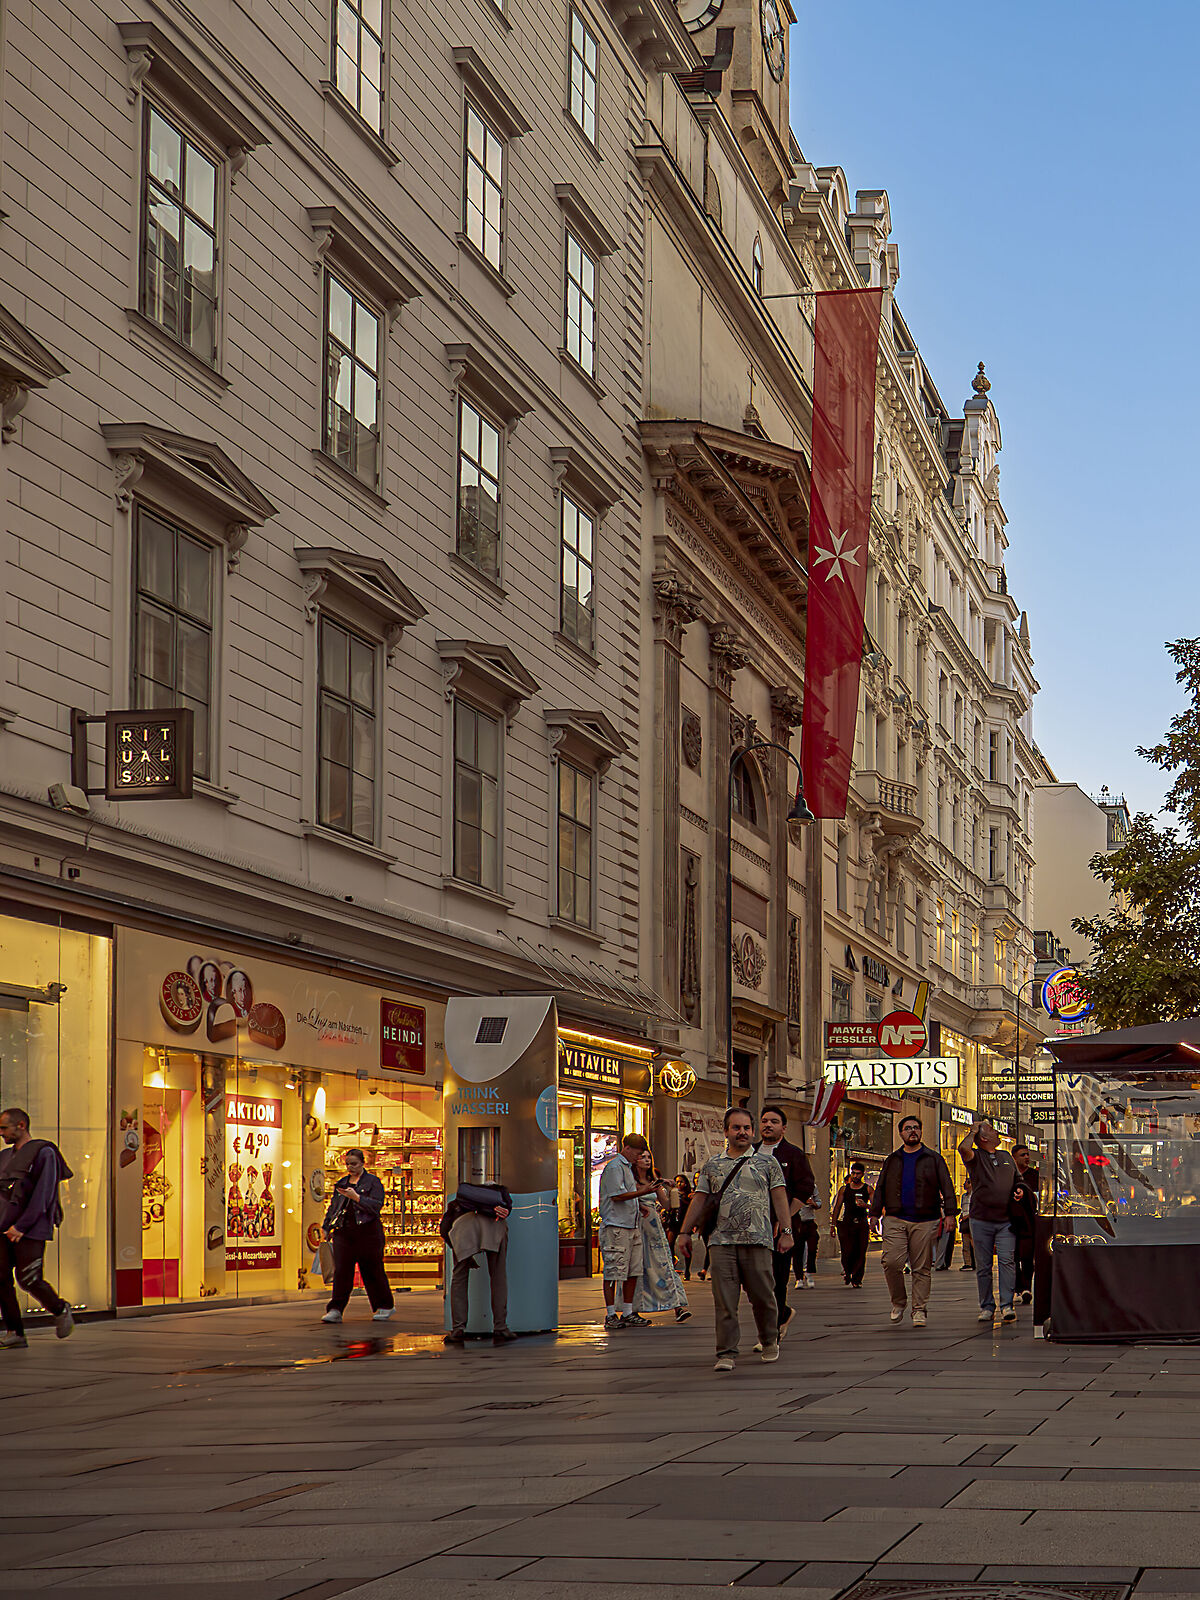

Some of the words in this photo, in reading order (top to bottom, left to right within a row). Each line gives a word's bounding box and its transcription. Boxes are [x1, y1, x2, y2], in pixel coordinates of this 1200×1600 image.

[296, 1013, 307, 1024] Die
[328, 1021, 338, 1029] am
[338, 1021, 363, 1035] Naschen
[832, 1026, 863, 1034] MAYR
[383, 1025, 423, 1046] HEINDL
[829, 1036, 876, 1044] FESSLER
[880, 1025, 926, 1046] MF
[565, 1050, 619, 1076] VITAVIEN
[825, 1061, 948, 1087] TARDI'S
[457, 1087, 500, 1099] TRINK
[1017, 1093, 1054, 1101] ALCONERI
[227, 1101, 276, 1123] AKTION
[451, 1102, 509, 1115] WASSER!
[233, 1136, 241, 1154] €
